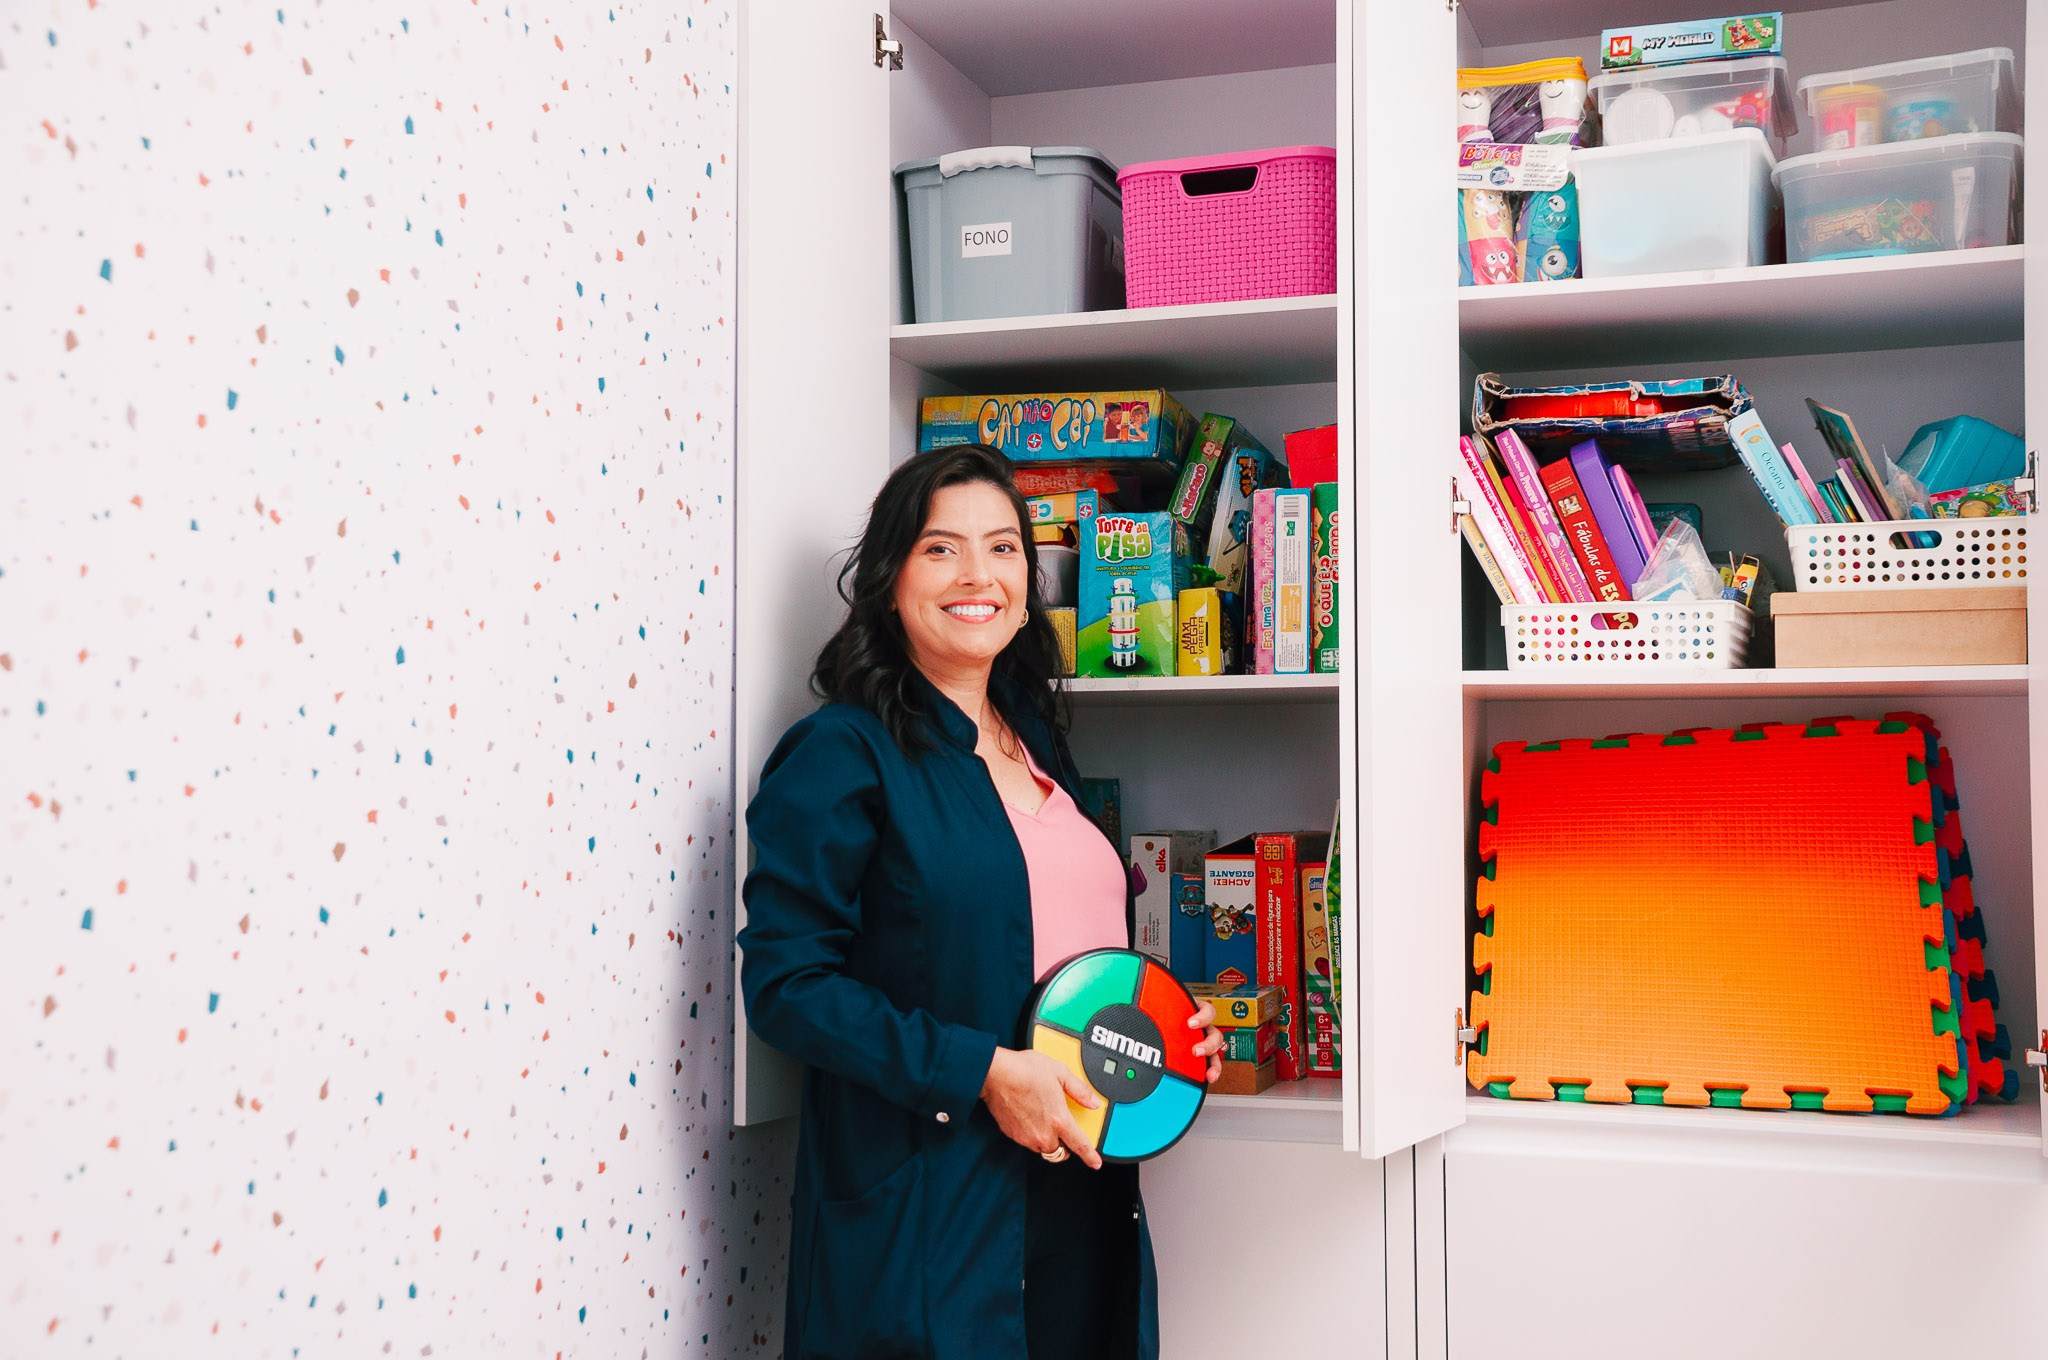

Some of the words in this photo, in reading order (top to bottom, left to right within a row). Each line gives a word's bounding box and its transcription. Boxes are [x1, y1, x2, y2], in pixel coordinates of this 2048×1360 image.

[1642, 37, 1666, 50] MY
[1667, 31, 1716, 47] WORLD
[1463, 147, 1519, 161] Boliche
[964, 229, 1009, 246] FONO
[1761, 451, 1785, 490] Oceano
[1262, 520, 1273, 576] Princesas
[1572, 520, 1601, 567] Fábulas
[1595, 567, 1612, 584] de
[1481, 551, 1496, 571] VAMOS
[1501, 587, 1511, 600] COM
[1263, 606, 1271, 627] uma
[1181, 622, 1190, 650] MAXI
[1262, 630, 1272, 648] Era
[1157, 848, 1166, 872] elka
[1266, 902, 1274, 921] figuras
[1274, 927, 1282, 951] observar
[1234, 1002, 1245, 1012] 4+
[1318, 1014, 1329, 1024] 6+
